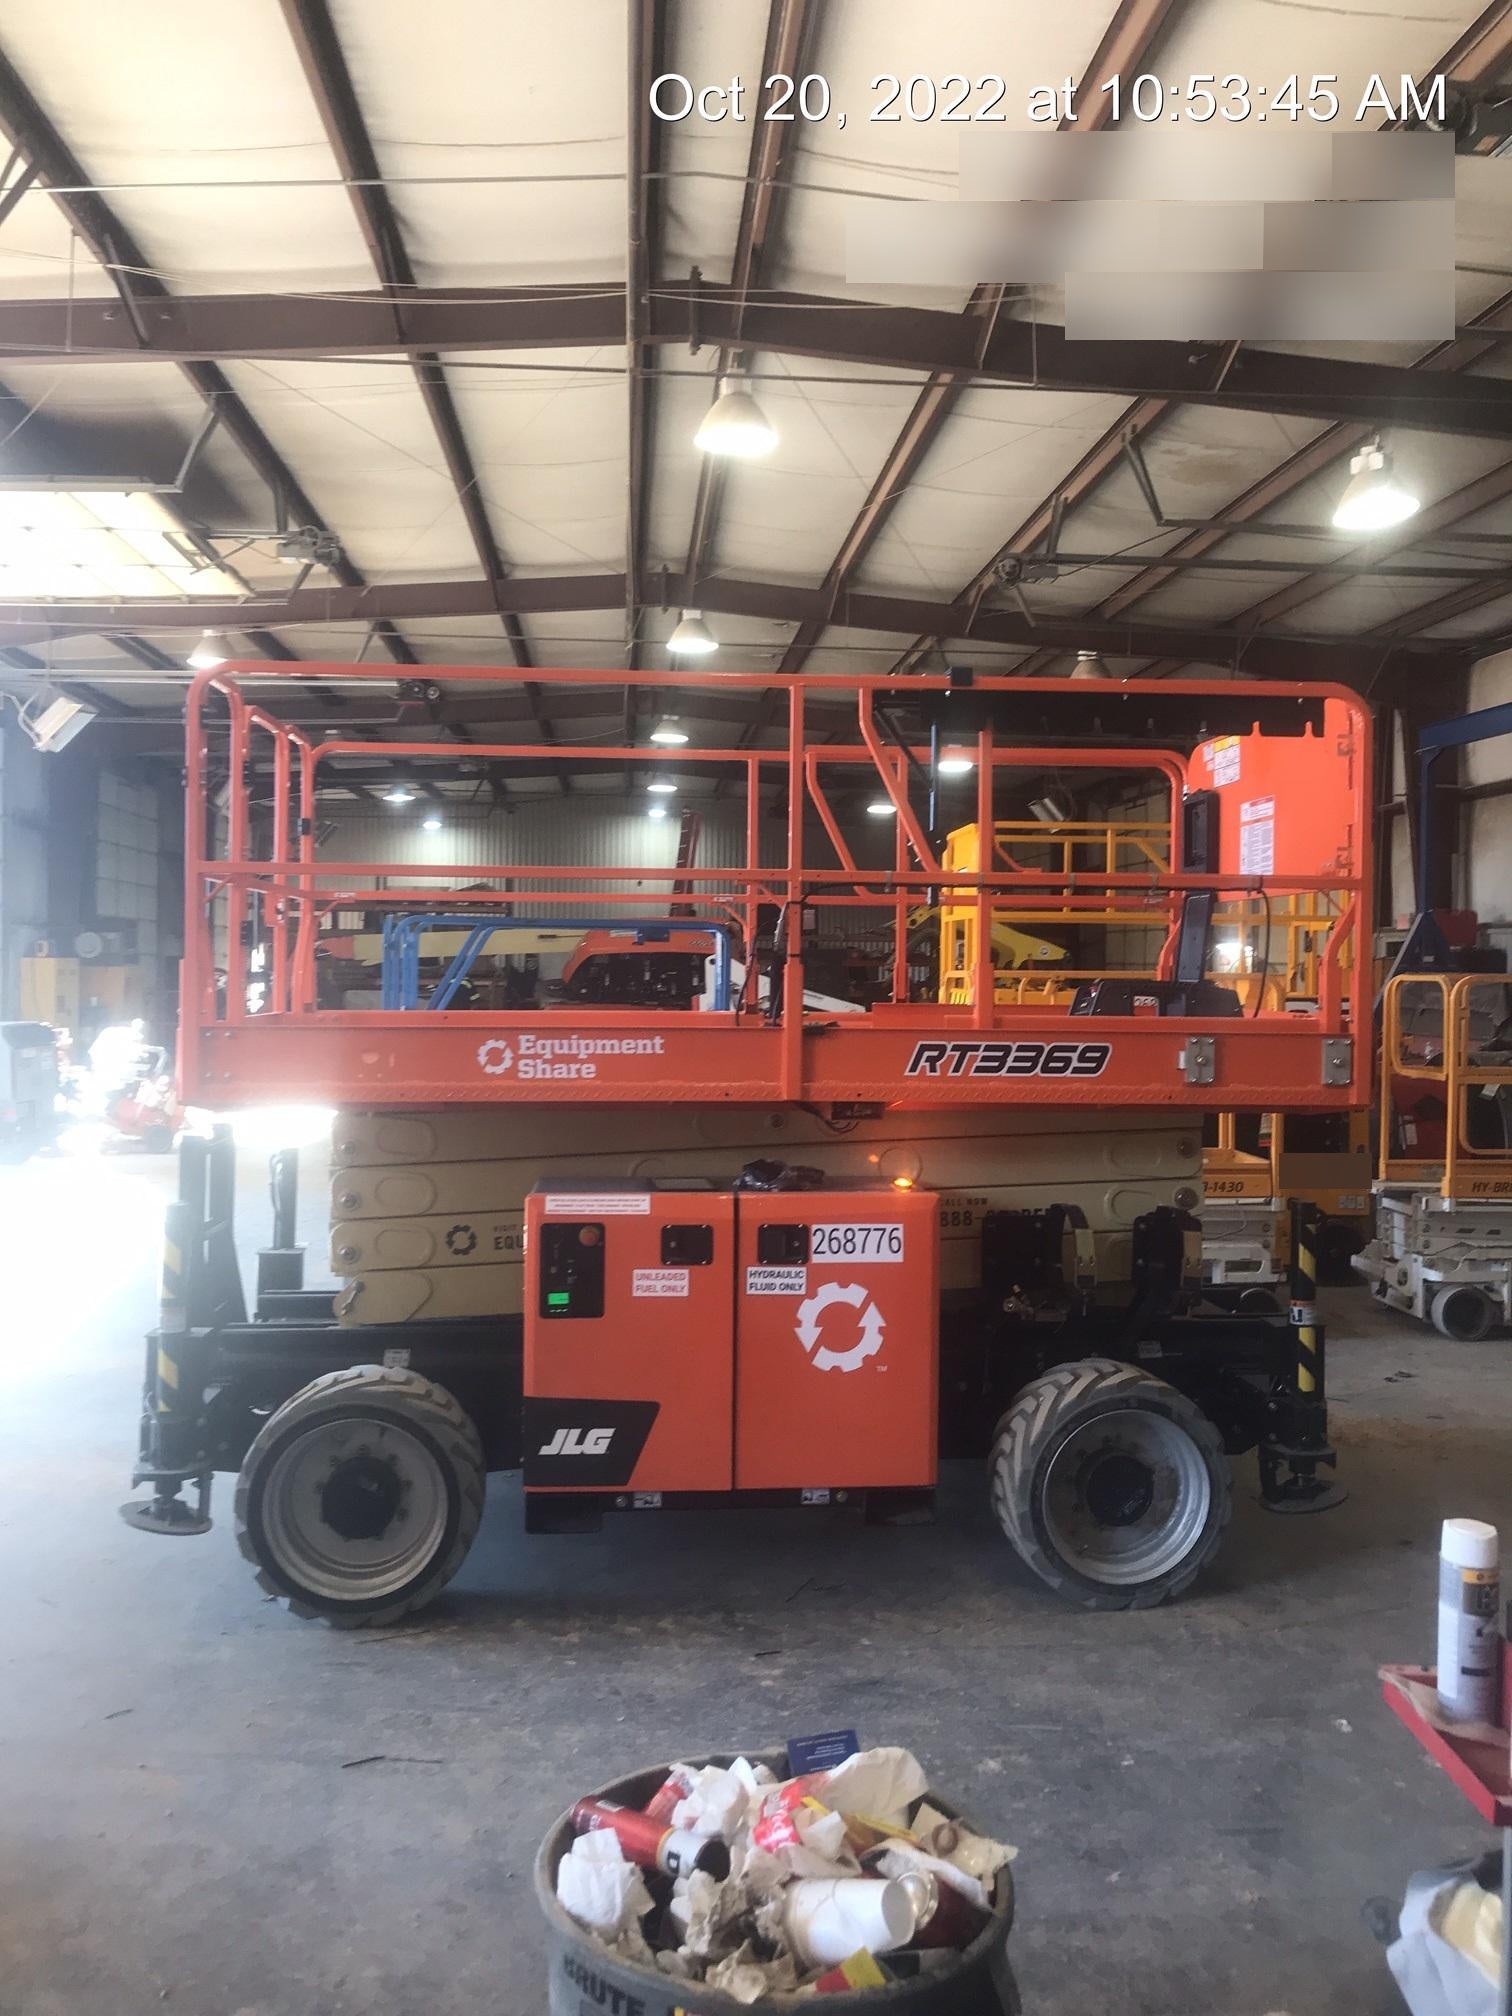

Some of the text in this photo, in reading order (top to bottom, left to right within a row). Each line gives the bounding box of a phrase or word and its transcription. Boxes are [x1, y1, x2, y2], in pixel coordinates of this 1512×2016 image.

[517, 1034, 665, 1059] Equipment
[517, 1059, 597, 1079] Share
[905, 1041, 1112, 1077] RT3369
[812, 1226, 902, 1256] 268776
[635, 1272, 686, 1281] UNLEADED
[748, 1270, 804, 1280] HYDRAULIC
[635, 1284, 687, 1294] FUEL ONLY
[748, 1282, 804, 1292] FLUID ONLY
[538, 1428, 616, 1455] JLG
